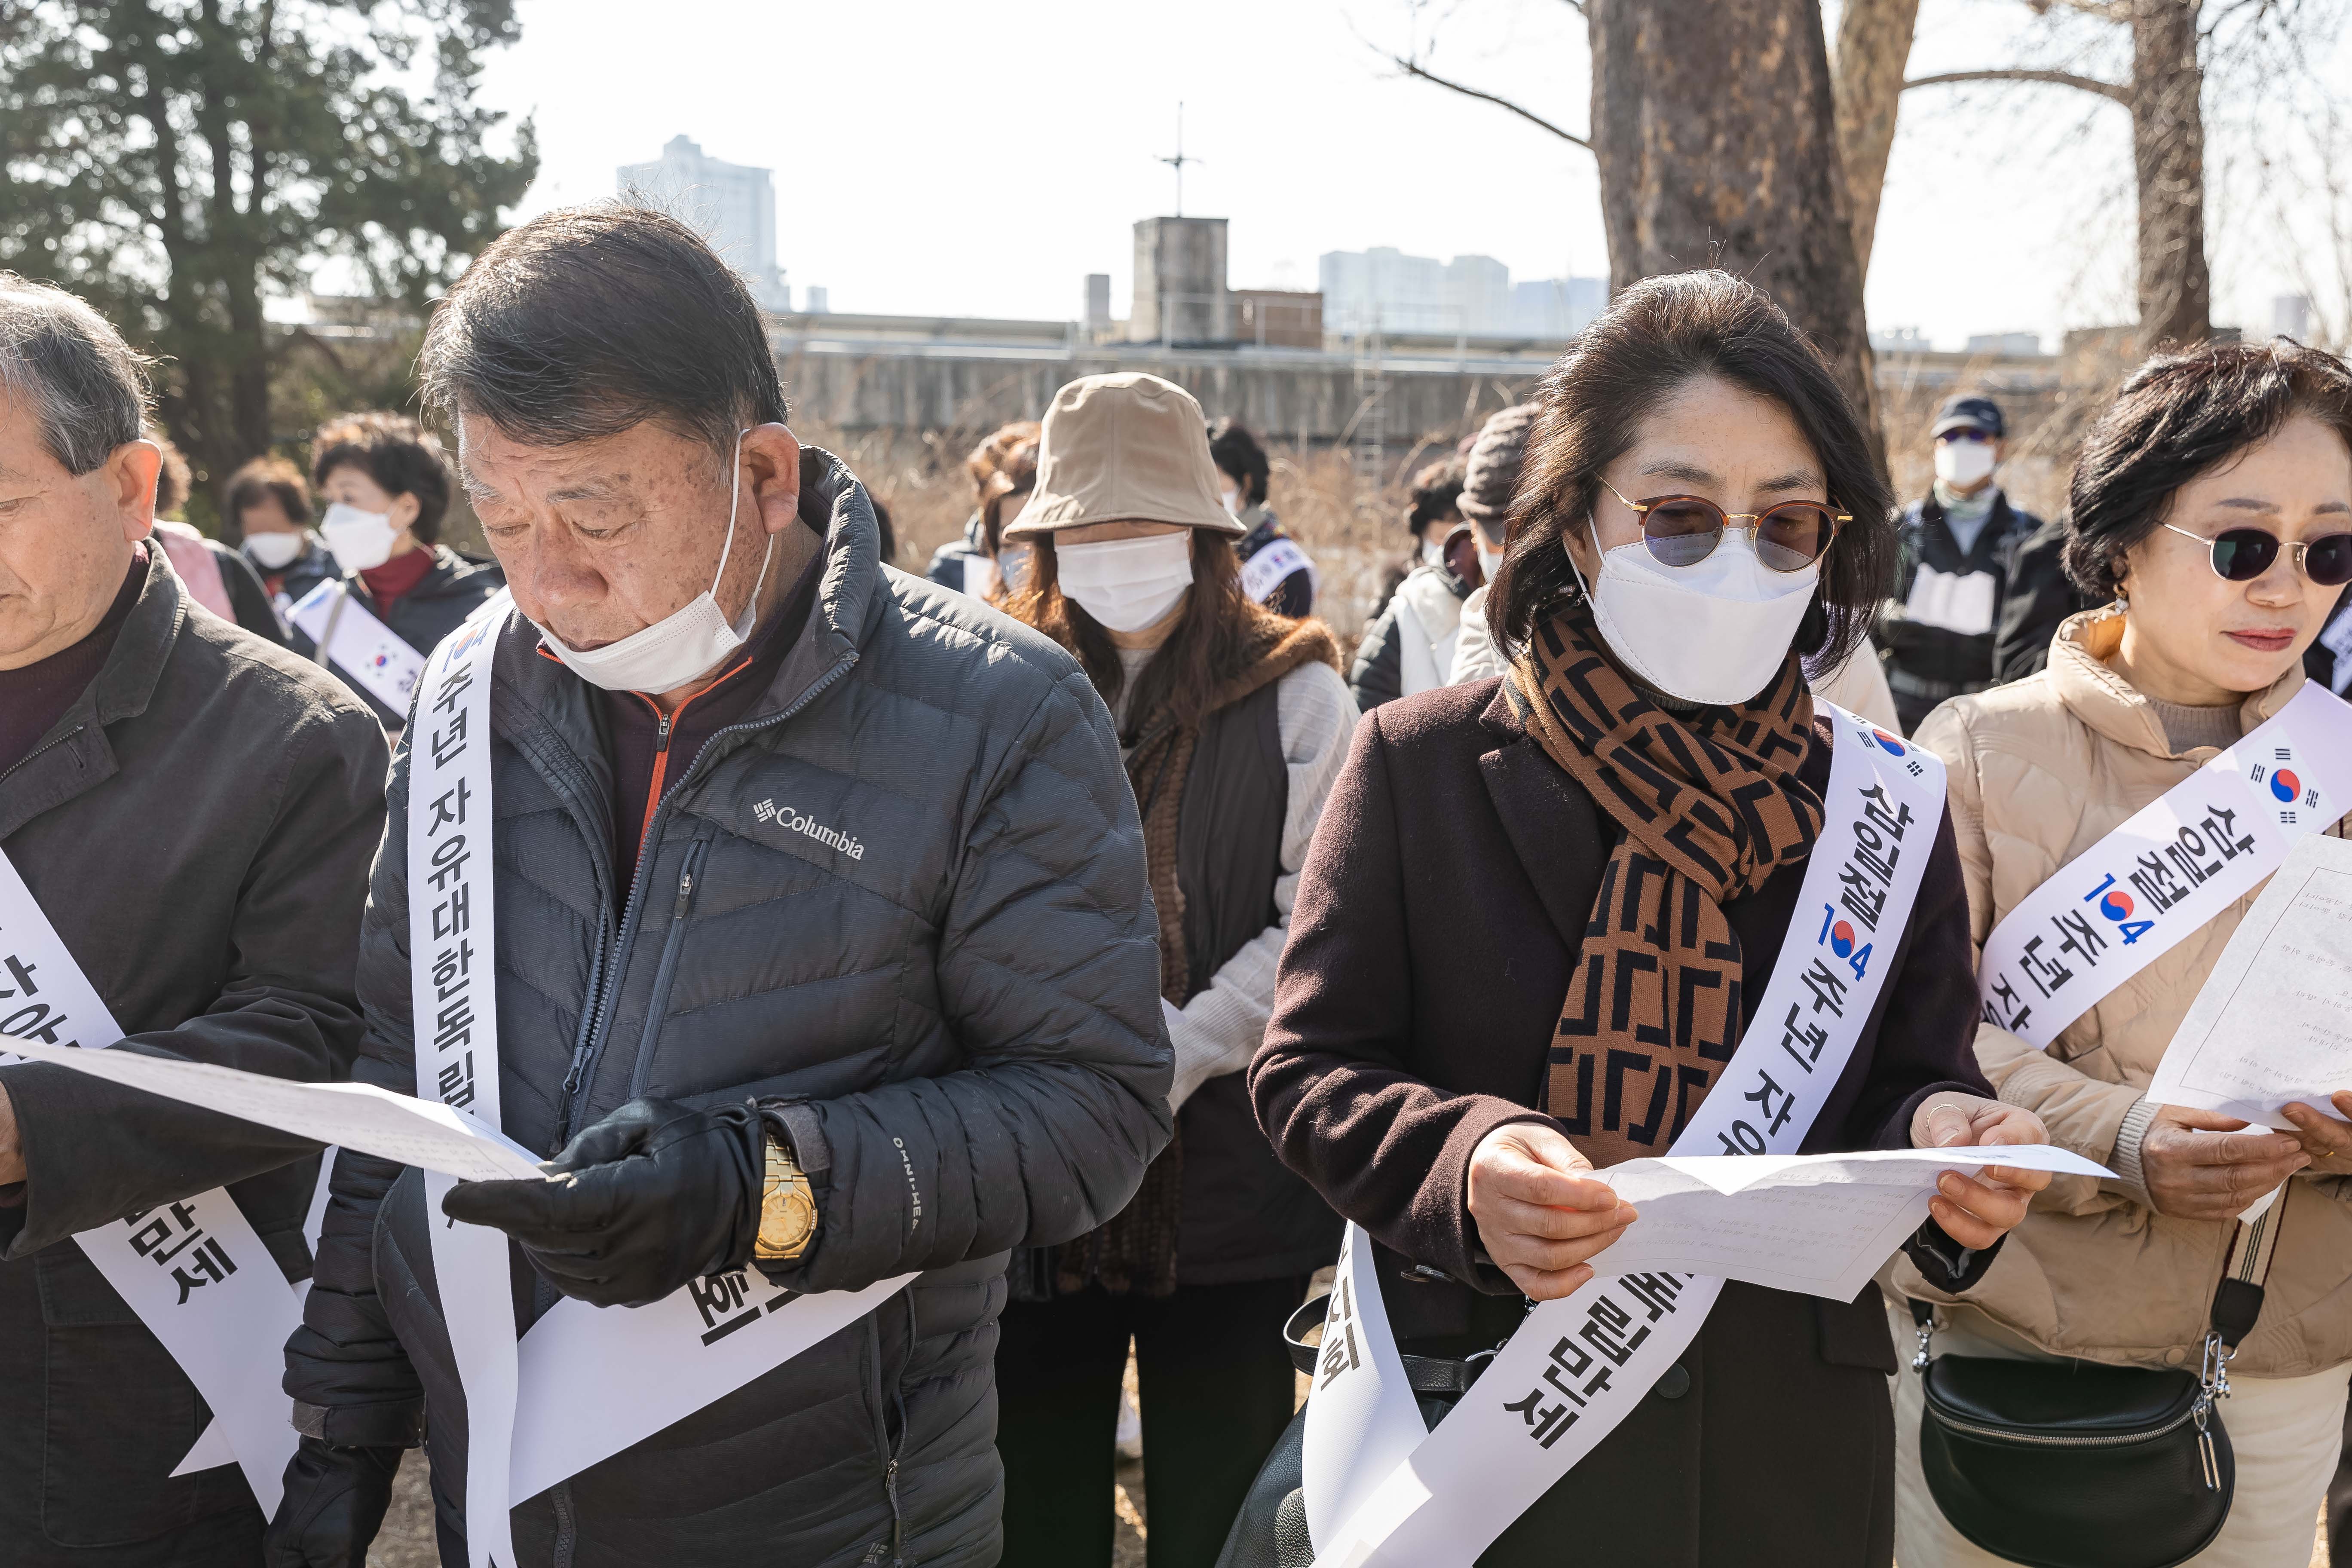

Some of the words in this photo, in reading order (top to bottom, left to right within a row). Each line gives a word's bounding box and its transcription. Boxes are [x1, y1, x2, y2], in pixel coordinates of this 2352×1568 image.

[775, 806, 865, 860] Columbia
[893, 1137, 922, 1235] OMNI-HEA
[123, 1202, 238, 1305] 만세
